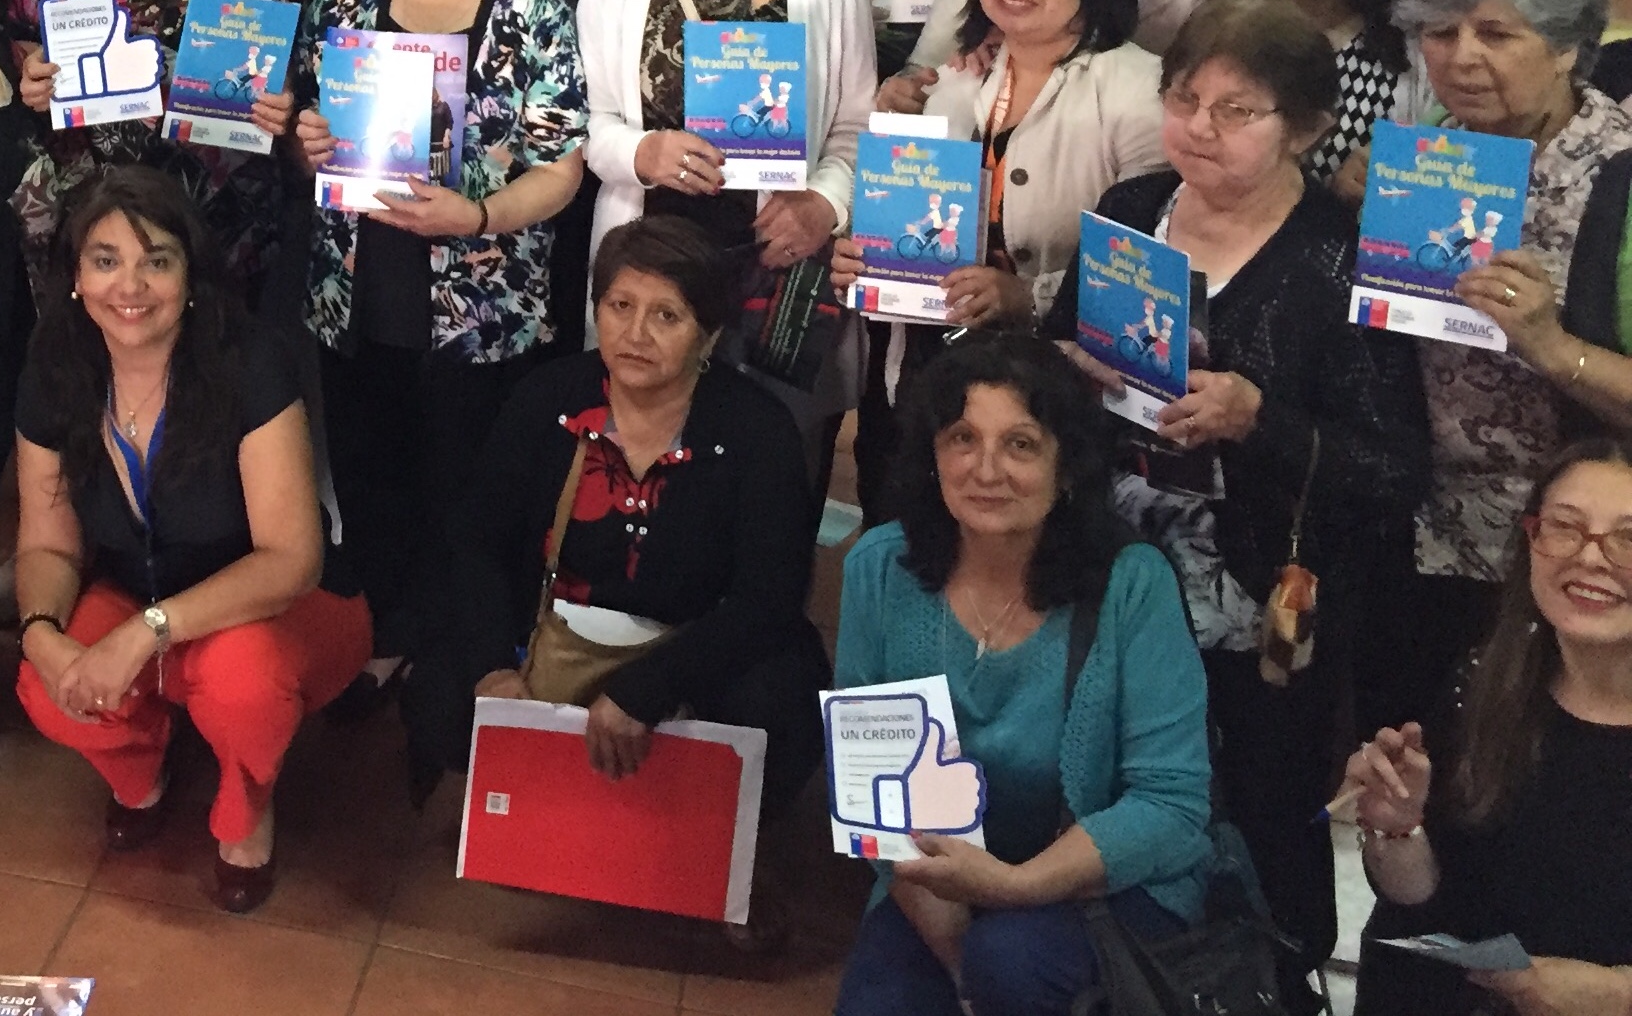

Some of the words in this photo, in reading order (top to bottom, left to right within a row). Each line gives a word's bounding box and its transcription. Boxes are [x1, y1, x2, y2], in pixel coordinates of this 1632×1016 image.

[52, 21, 66, 31] UN
[68, 15, 109, 29] CRÉDITO
[435, 52, 462, 72] de
[1444, 317, 1495, 337] SERNAC
[841, 730, 859, 740] UN
[862, 728, 916, 740] CRÉDITO
